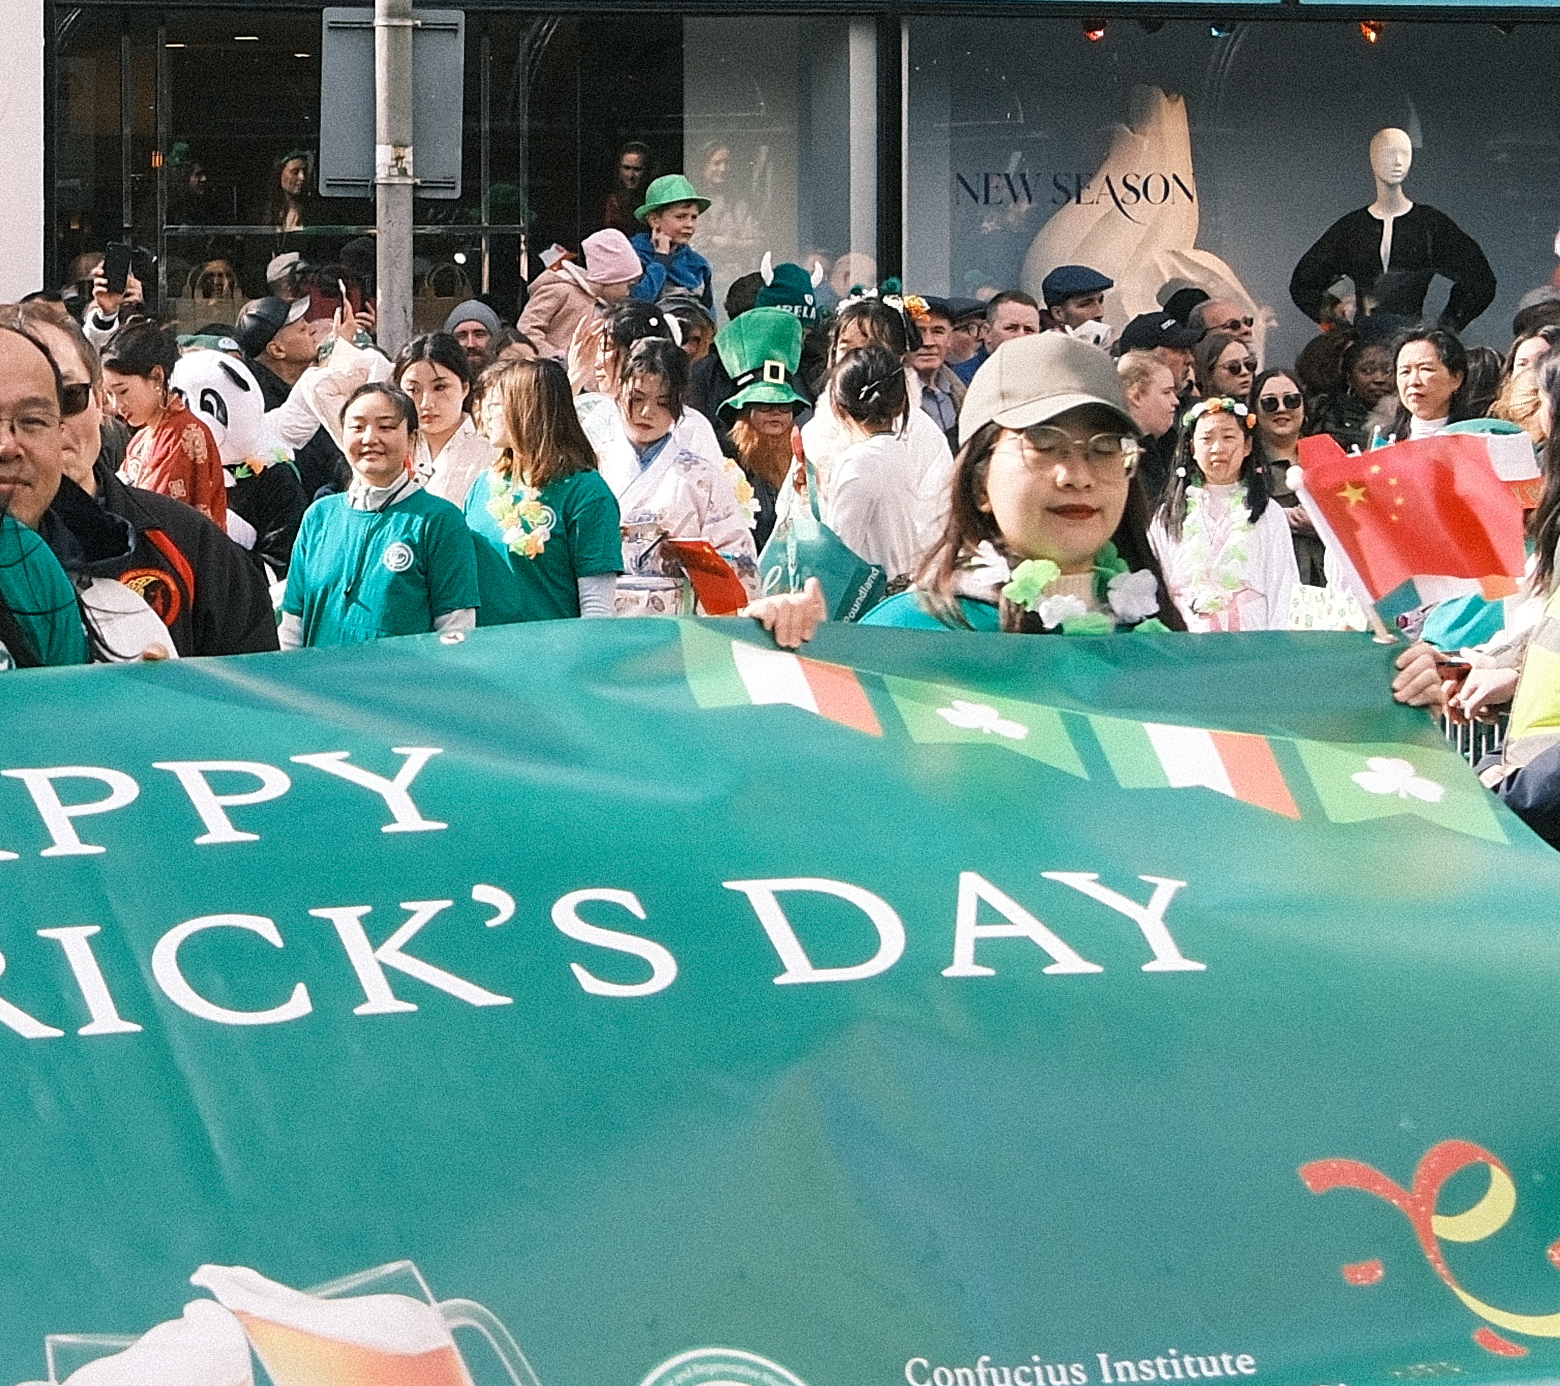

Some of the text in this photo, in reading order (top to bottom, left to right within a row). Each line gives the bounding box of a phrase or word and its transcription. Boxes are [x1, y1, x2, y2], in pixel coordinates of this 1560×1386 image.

[955, 171, 1195, 225] NEW SEASON
[842, 566, 880, 624] Poundland
[723, 870, 1208, 985] DAY
[1096, 1349, 1258, 1385] Institute
